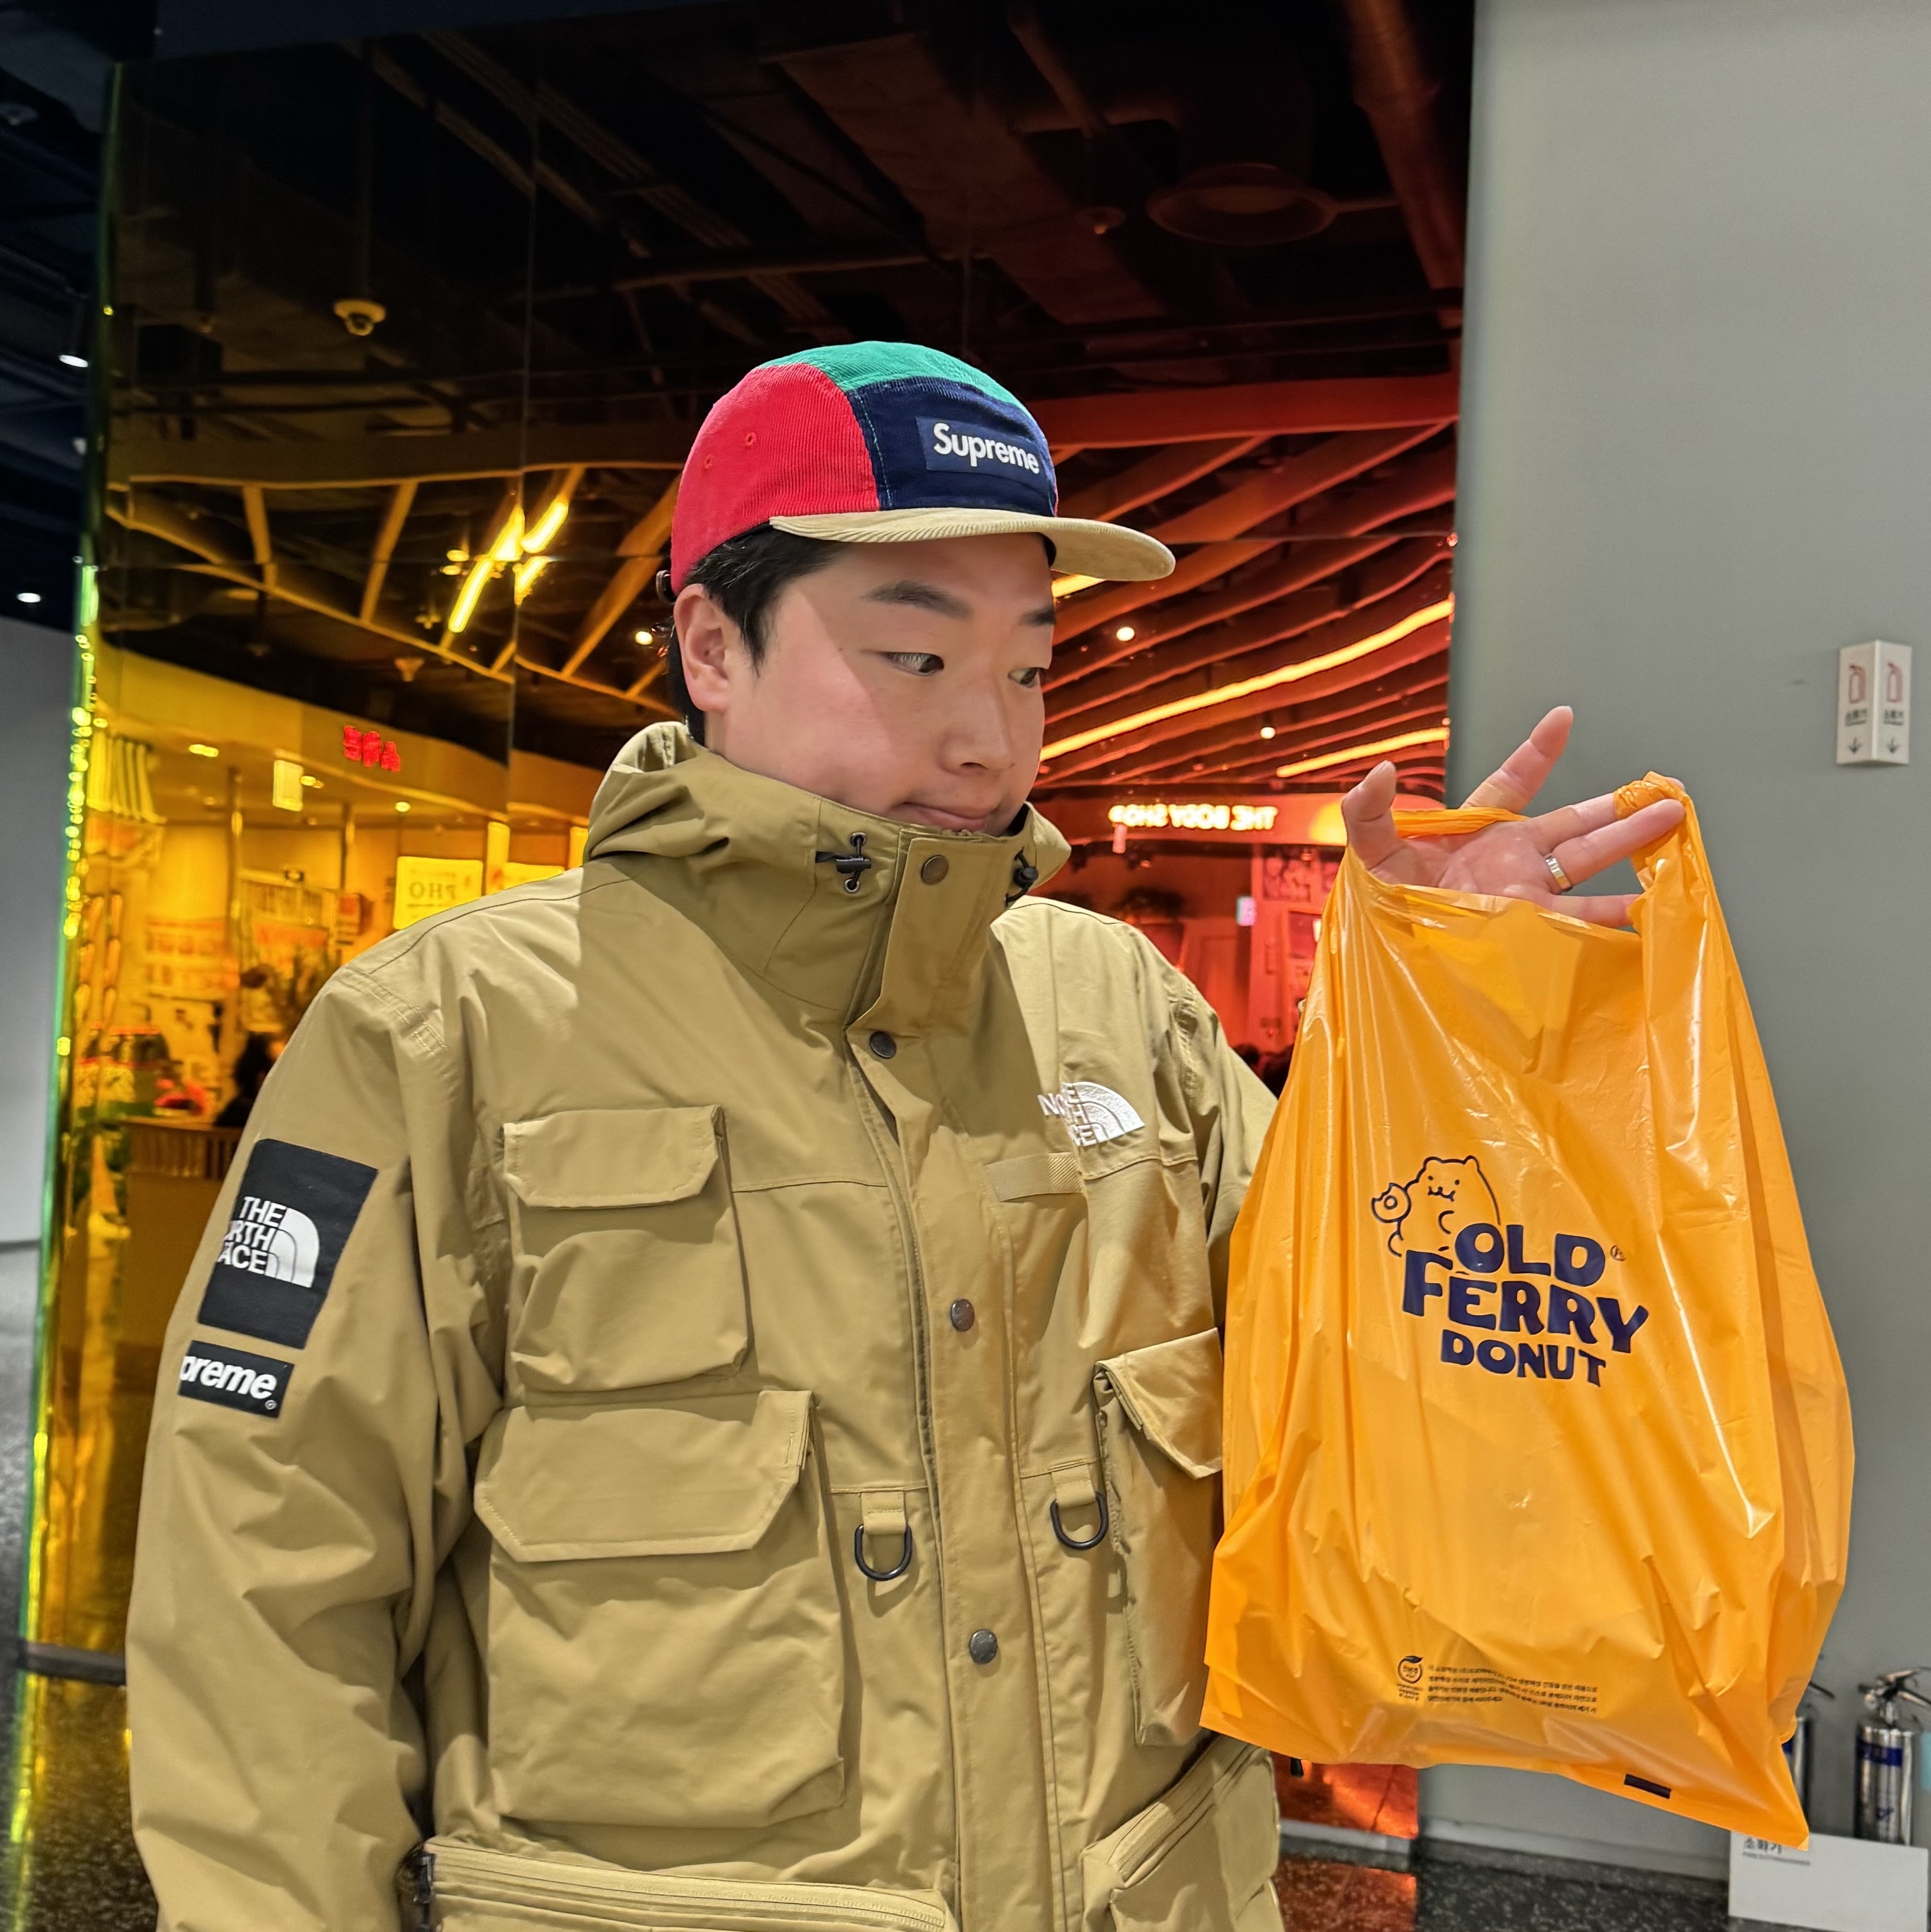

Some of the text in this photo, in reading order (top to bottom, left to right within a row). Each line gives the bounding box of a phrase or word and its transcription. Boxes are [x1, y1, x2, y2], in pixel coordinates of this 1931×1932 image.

[933, 423, 1040, 475] Supreme
[224, 1220, 276, 1251] RTH
[238, 1196, 287, 1228] THE
[217, 1241, 267, 1275] ACE
[1455, 1222, 1606, 1287] OLD
[1402, 1249, 1649, 1354] FERRY
[1440, 1329, 1606, 1387] DONUT
